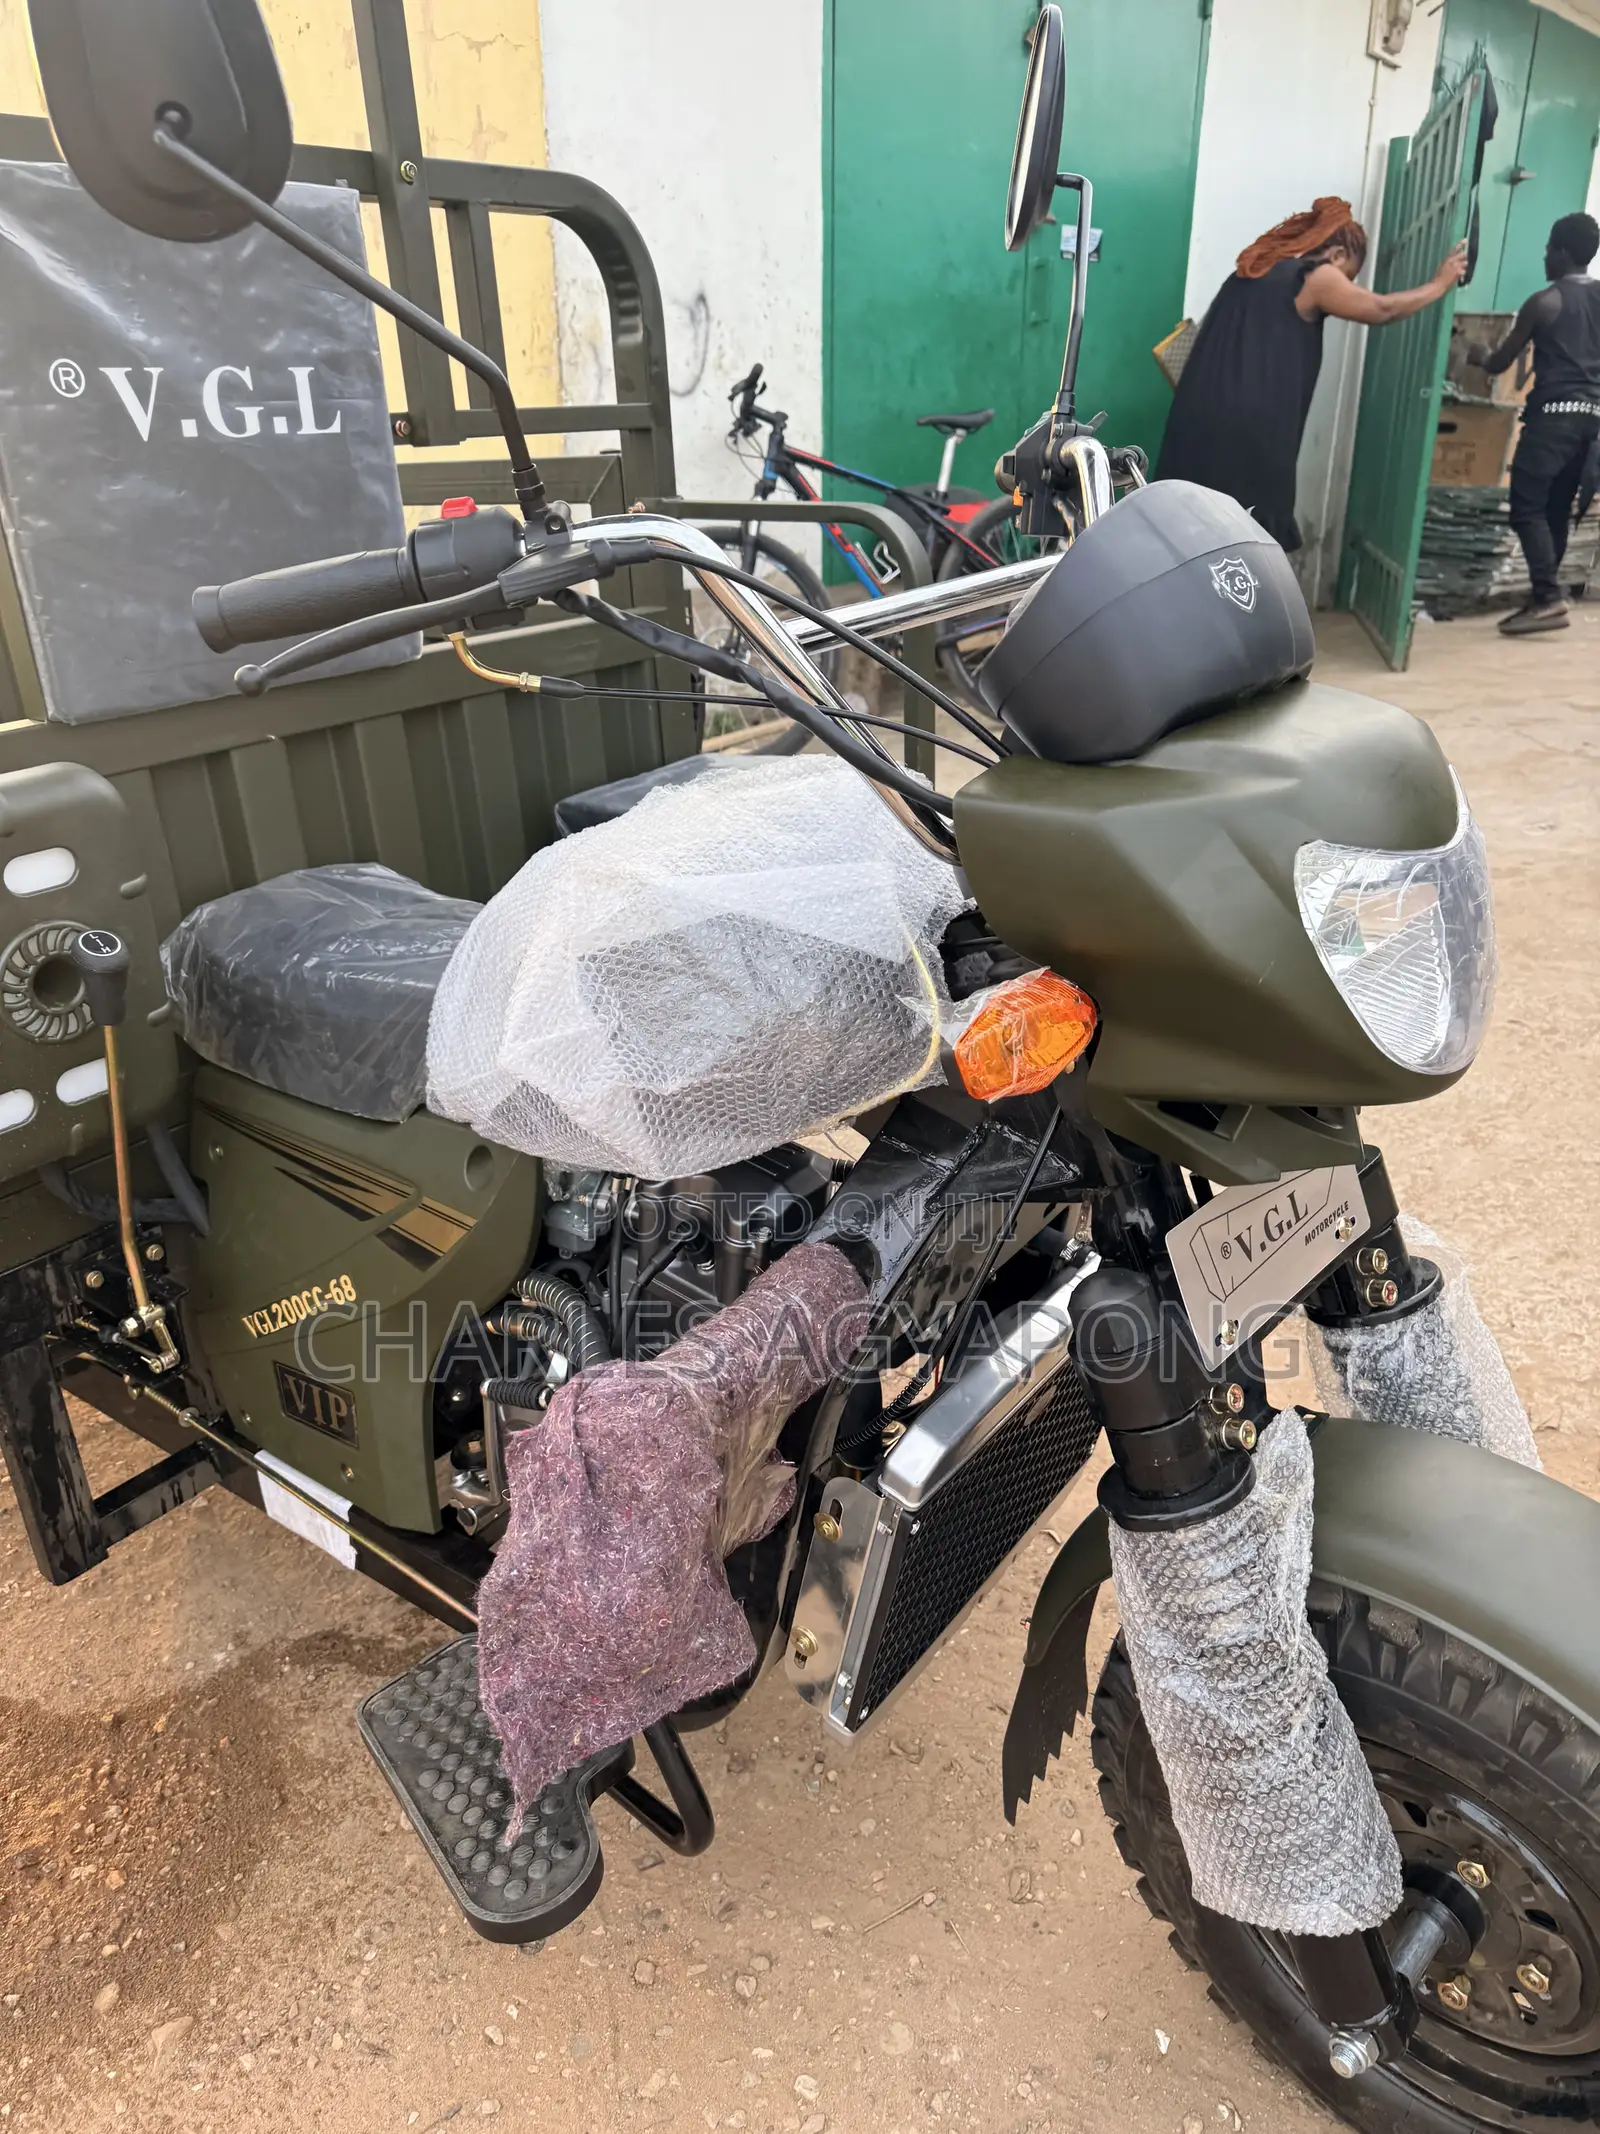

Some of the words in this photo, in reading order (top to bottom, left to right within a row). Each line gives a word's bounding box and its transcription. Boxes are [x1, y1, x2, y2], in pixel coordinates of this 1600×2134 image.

[98, 365, 342, 442] V.G.L
[1233, 1190, 1309, 1263] V.G.L
[1303, 1200, 1350, 1247] MOTORCYCLE
[240, 1274, 357, 1340] VGL200CC-68
[284, 1373, 348, 1432] VIP
